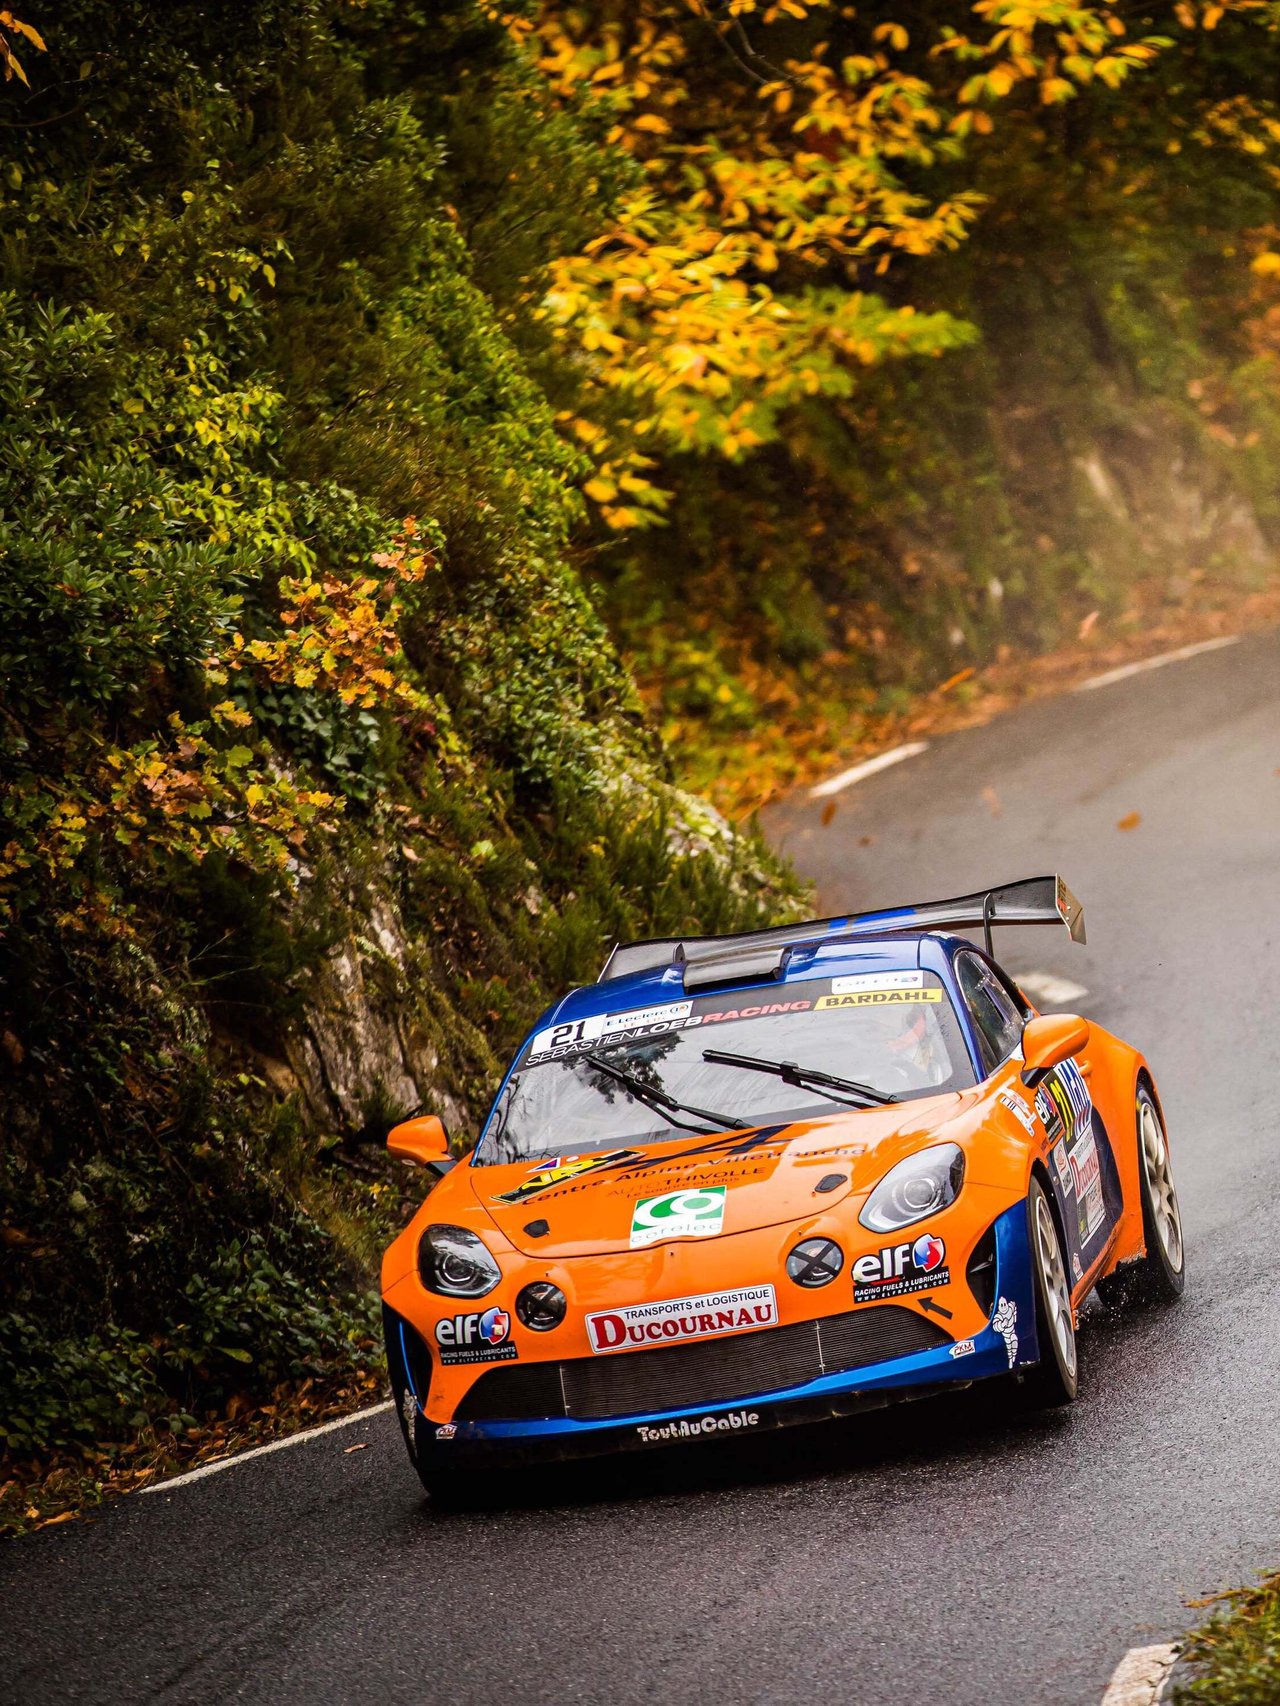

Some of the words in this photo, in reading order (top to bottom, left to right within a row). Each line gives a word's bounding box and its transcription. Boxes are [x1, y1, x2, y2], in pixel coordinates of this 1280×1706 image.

[825, 991, 935, 1007] BARDAHL
[550, 1020, 586, 1048] 21
[522, 1179, 606, 1206] Centre
[615, 1163, 697, 1183] Alpine
[631, 1223, 720, 1243] corelec
[852, 1244, 910, 1283] elf
[854, 1286, 881, 1297] RACING
[882, 1281, 903, 1292] FUELS
[911, 1271, 950, 1286] LUBRICANTS
[625, 1301, 693, 1320] TRANSPORTS
[694, 1301, 706, 1310] et
[706, 1289, 770, 1307] LOGISTIQUE
[435, 1314, 479, 1345] elf
[480, 1346, 516, 1356] LUBRICANTS
